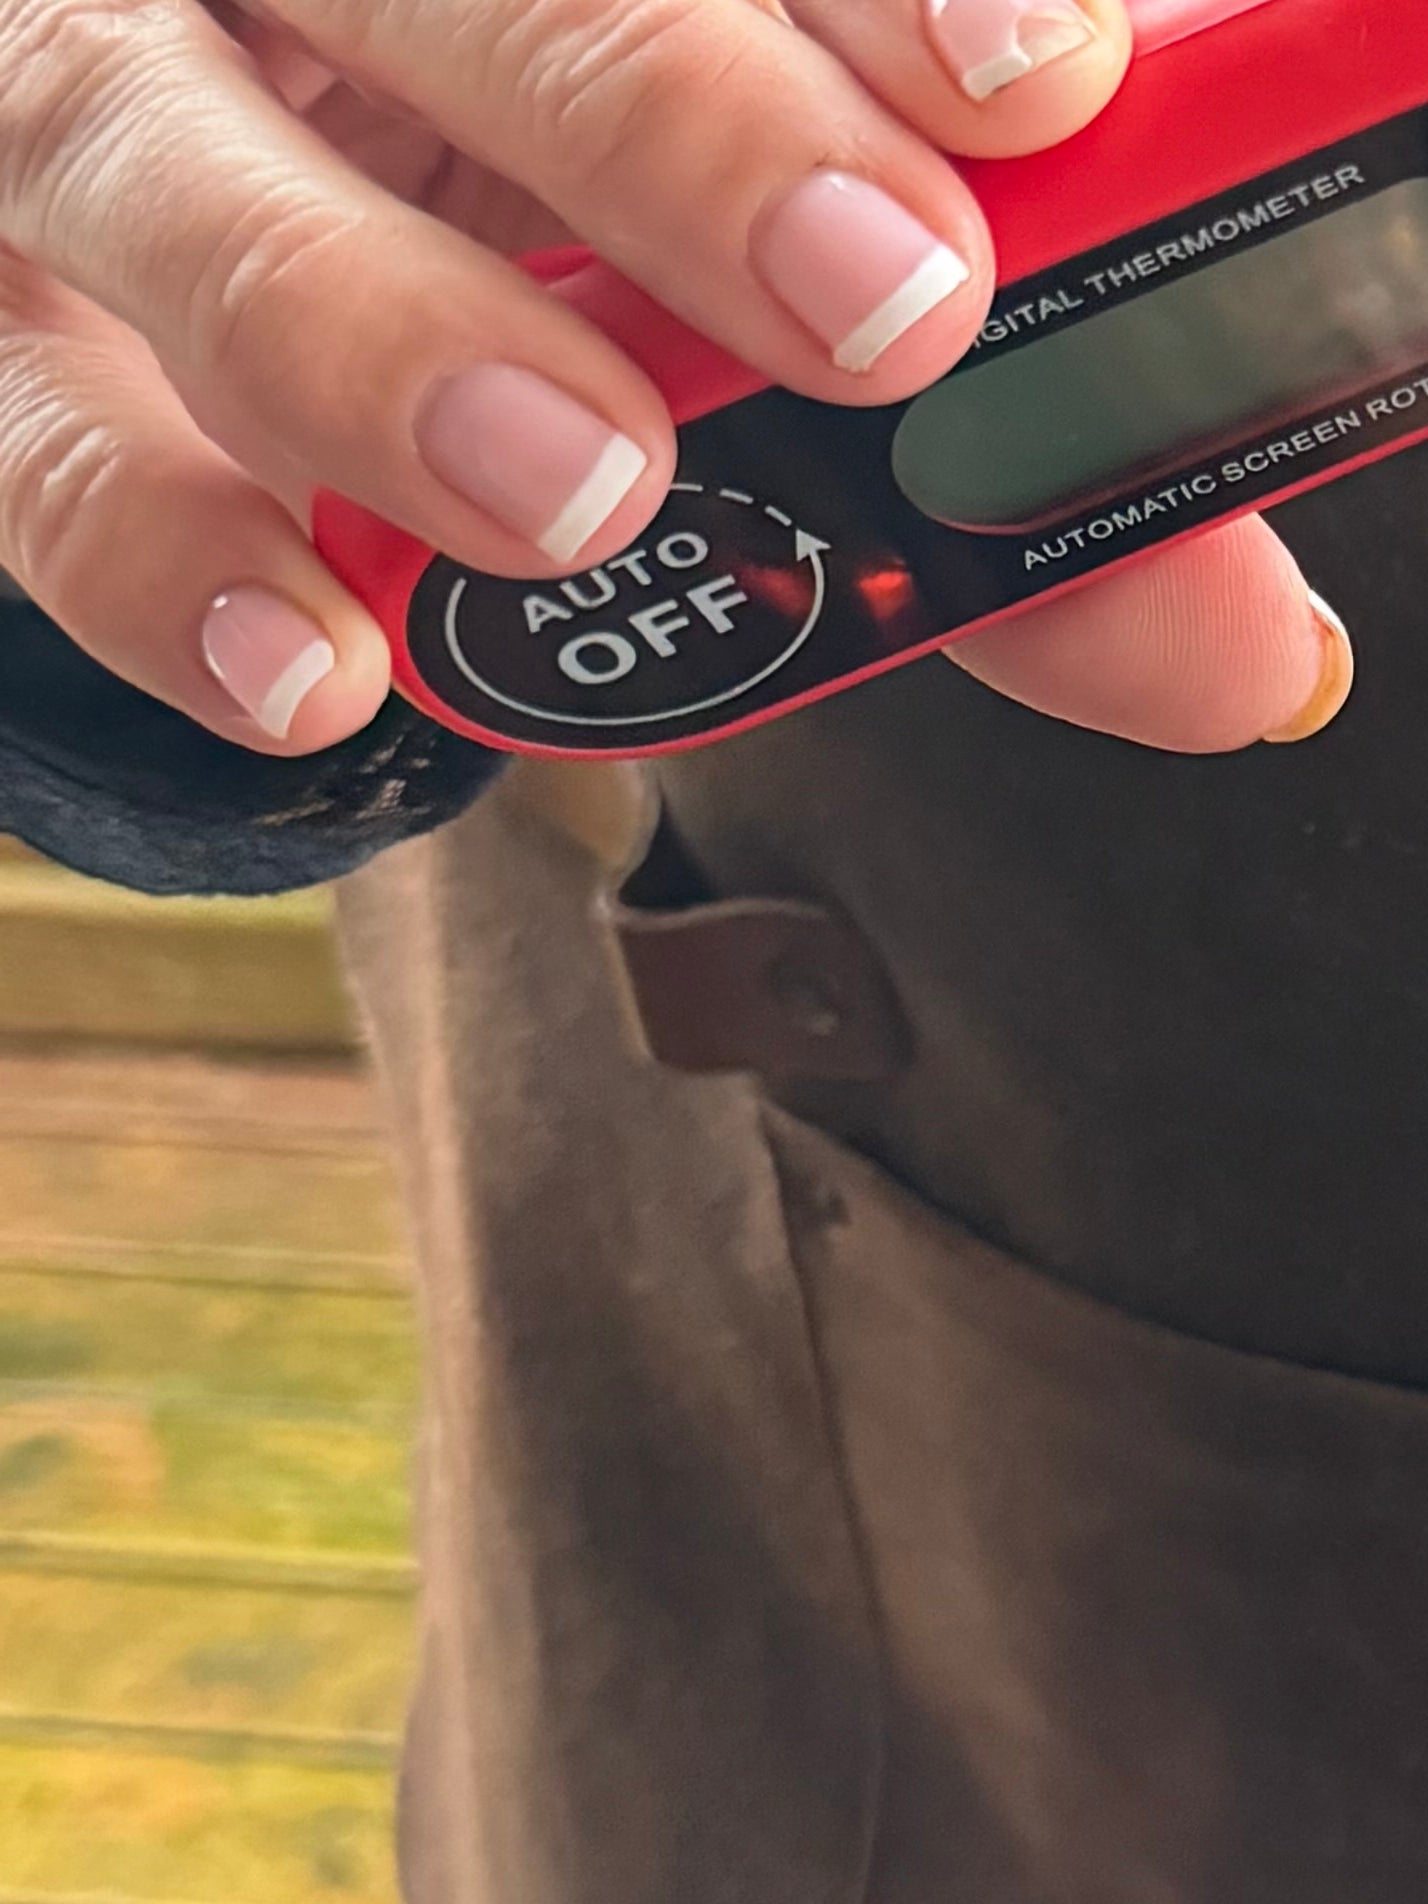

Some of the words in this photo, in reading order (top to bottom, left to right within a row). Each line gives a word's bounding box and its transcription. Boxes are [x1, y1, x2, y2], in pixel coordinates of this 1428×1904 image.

[1085, 163, 1365, 297] THERMOMETER
[1023, 473, 1218, 571] AUTOMATIC
[1221, 409, 1361, 484] SCREEN
[522, 531, 709, 634] AUTO
[557, 574, 748, 684] OFF
